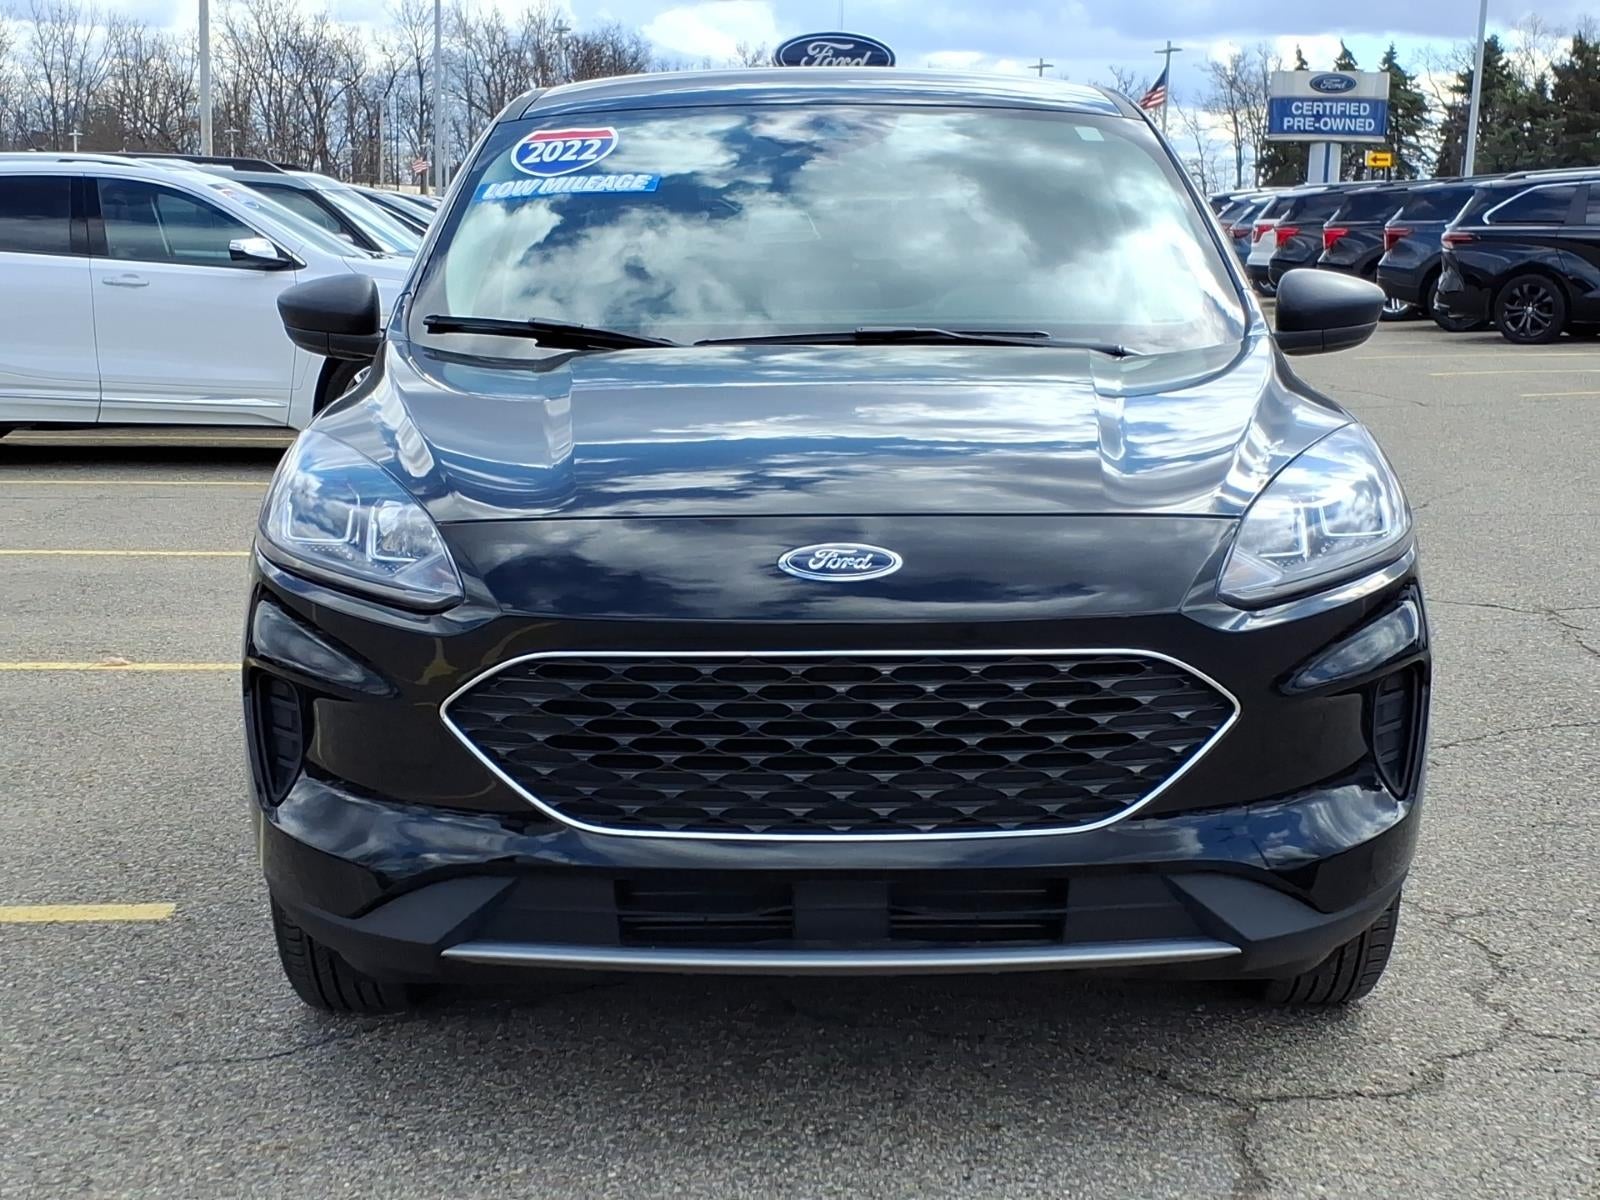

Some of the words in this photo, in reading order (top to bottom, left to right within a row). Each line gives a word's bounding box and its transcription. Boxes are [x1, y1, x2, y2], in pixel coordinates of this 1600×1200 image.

[1320, 79, 1347, 89] Ford
[1291, 102, 1370, 116] CERTIFIED
[1283, 117, 1375, 131] PRE-OWNED
[522, 139, 602, 164] 2022
[482, 178, 542, 200] LOW
[538, 174, 652, 193] MILEAGE
[808, 549, 873, 569] Ford
